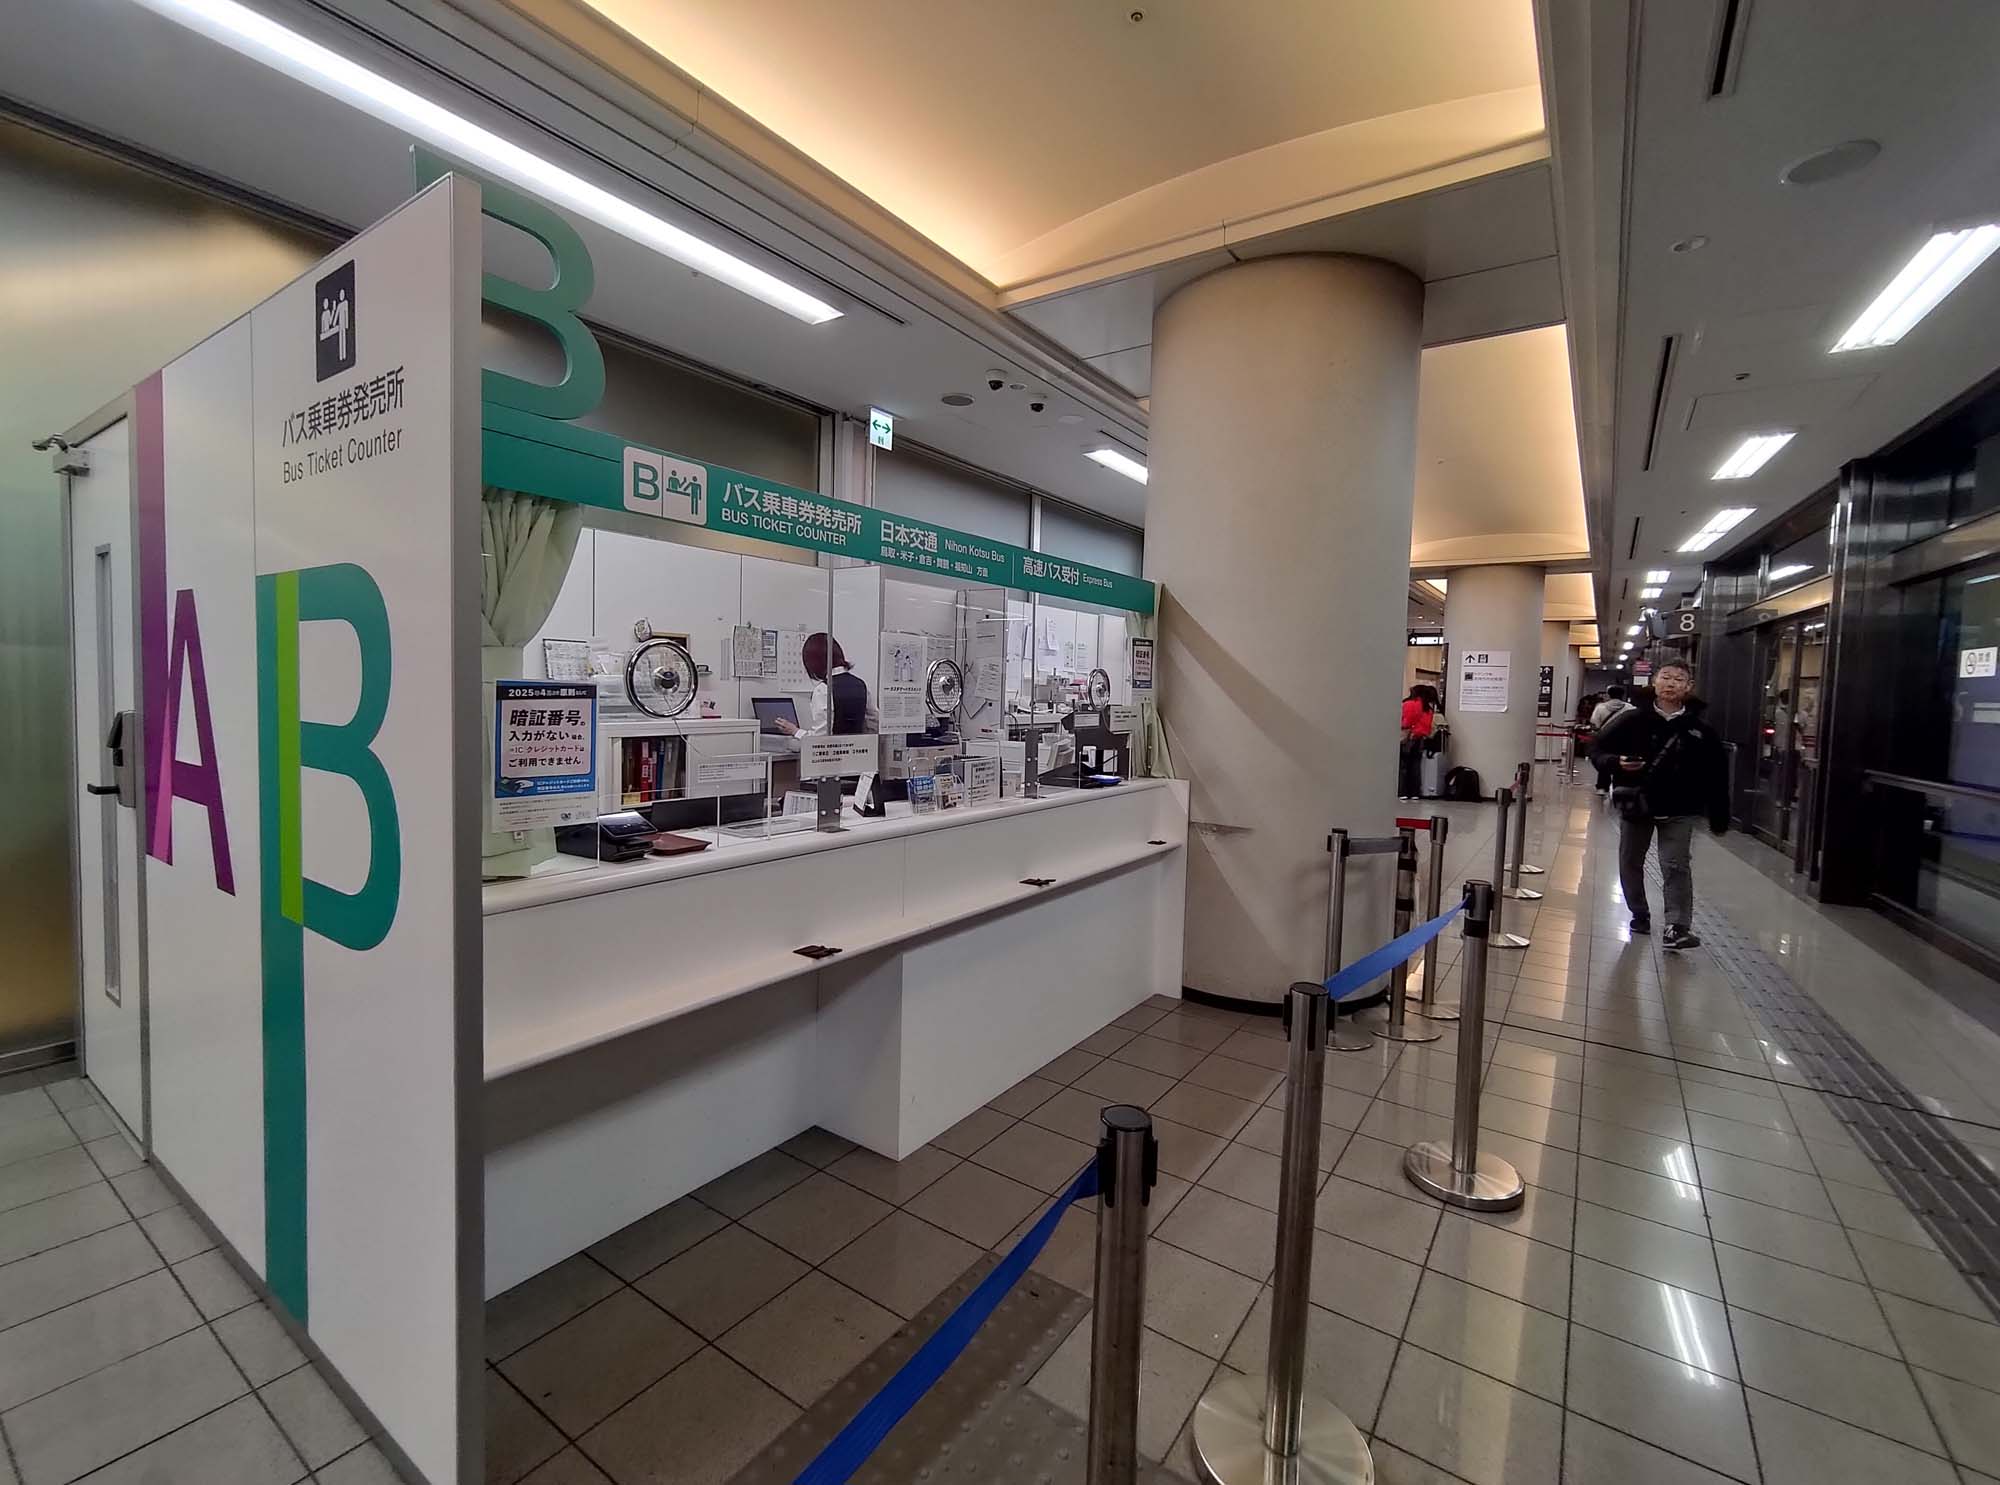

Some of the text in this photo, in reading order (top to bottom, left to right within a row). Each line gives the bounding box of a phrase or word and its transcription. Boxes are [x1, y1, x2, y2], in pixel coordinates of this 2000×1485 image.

[409, 143, 606, 421] B
[282, 366, 405, 448] バス乗車券発売所
[283, 428, 402, 484] Bus Ticket Counter
[632, 461, 660, 501] B
[721, 508, 847, 547] BUS TICKET COUNTER
[722, 482, 862, 536] バス乗車券発売所
[881, 519, 1005, 563] 日本交通 Nihon Kotsu Bus
[1023, 556, 1113, 589] 高速バス受付 Express Bus
[1680, 613, 1695, 631] 8
